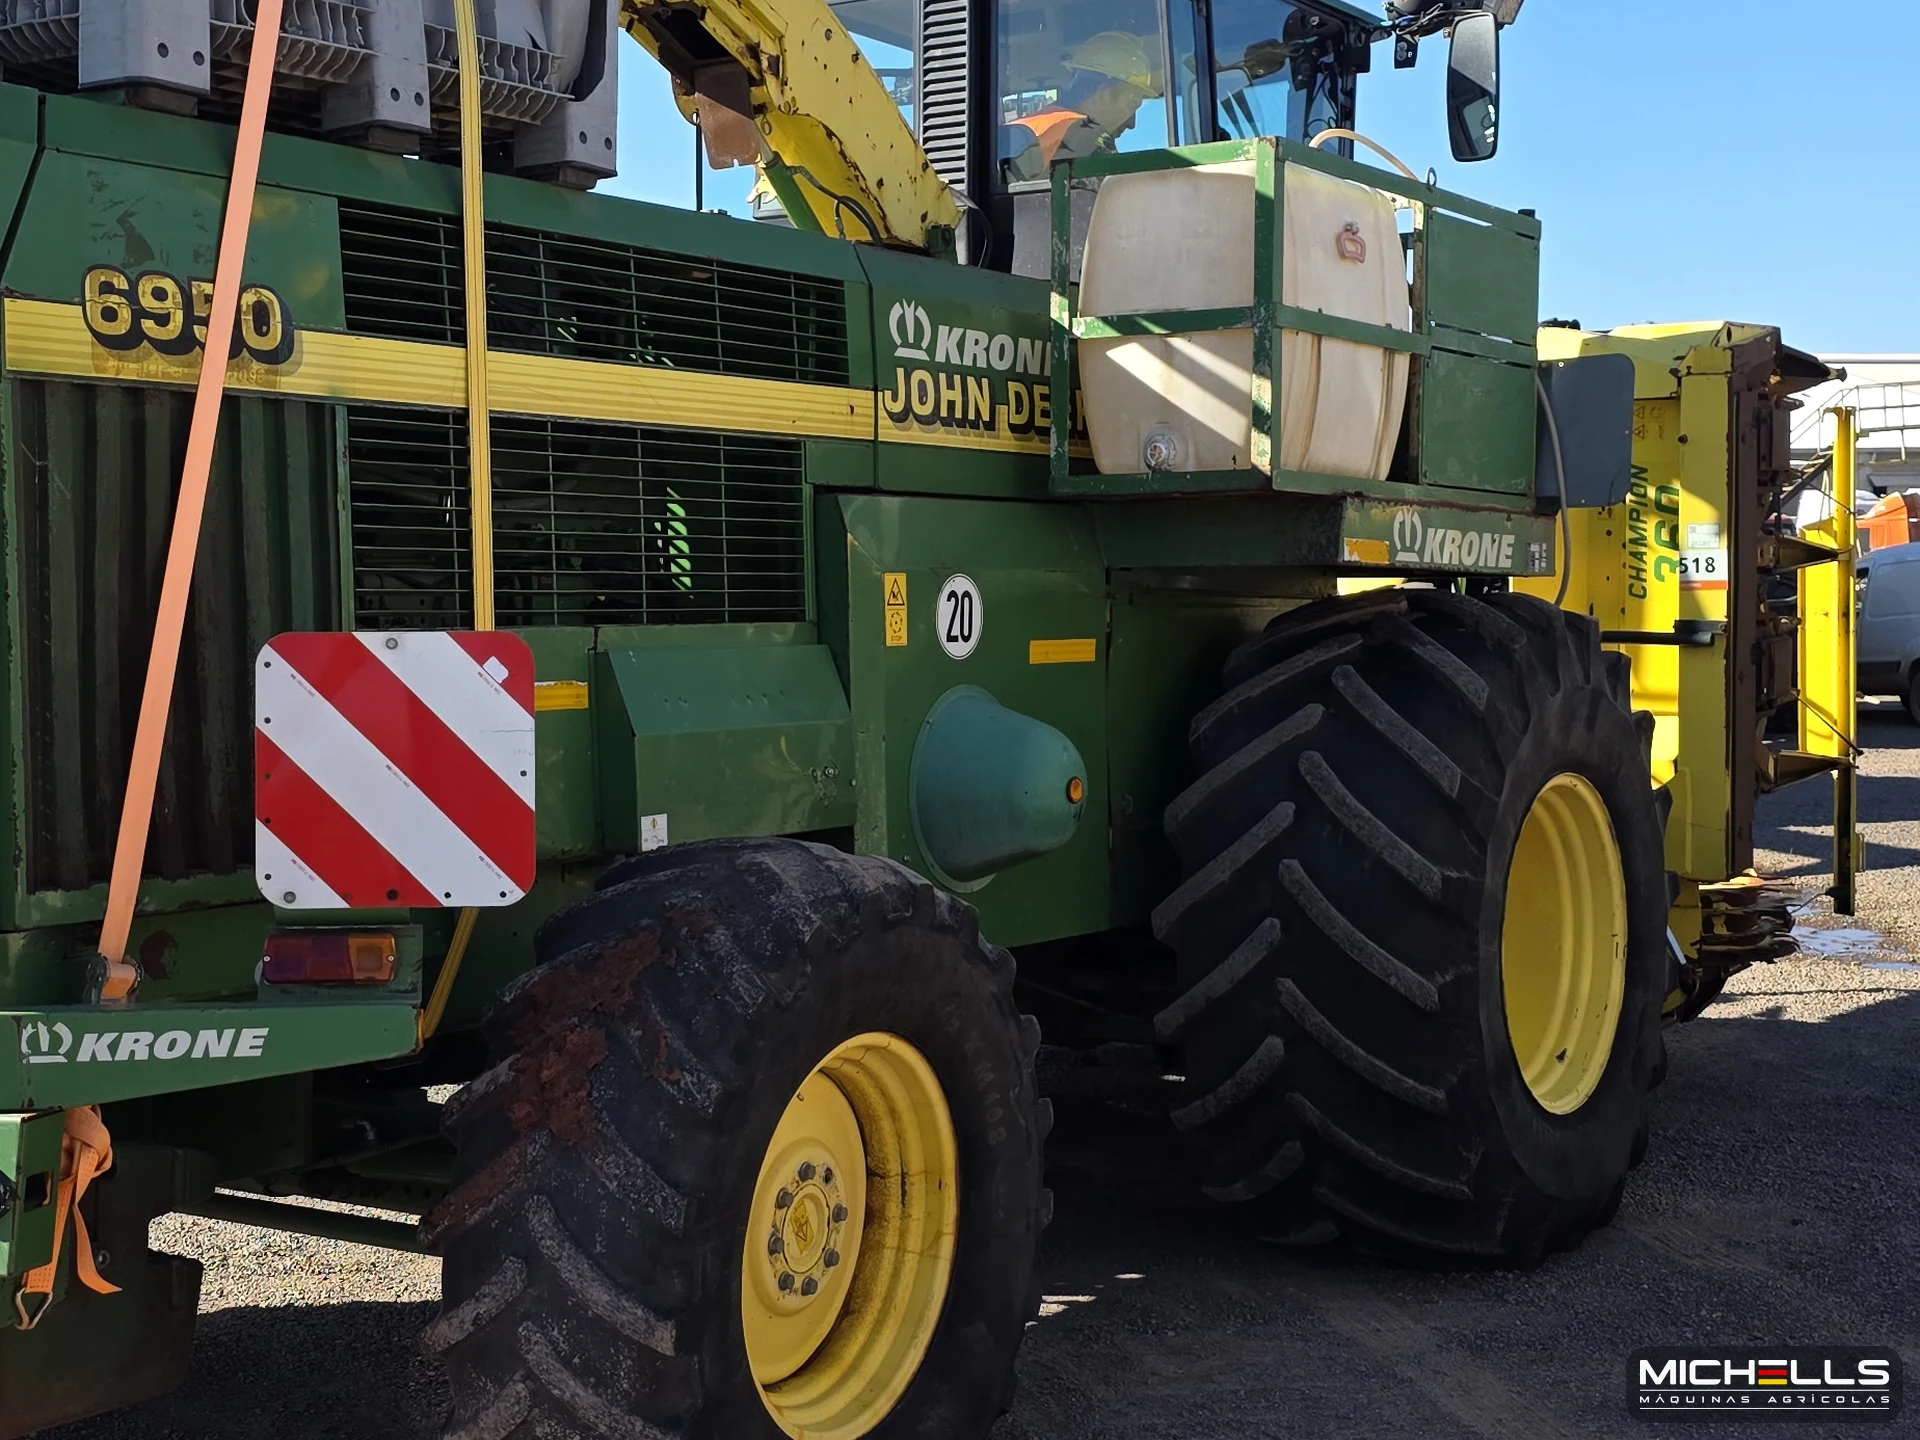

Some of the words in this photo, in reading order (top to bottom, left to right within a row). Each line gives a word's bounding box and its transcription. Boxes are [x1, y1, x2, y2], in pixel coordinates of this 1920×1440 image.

[884, 367, 994, 428] JOHN
[1423, 527, 1516, 569] KRONE
[1628, 464, 1648, 599] CHAMPION
[1654, 484, 1680, 583] 360
[1679, 556, 1716, 574] 518
[946, 589, 973, 643] 20
[76, 1027, 269, 1062] KRONE
